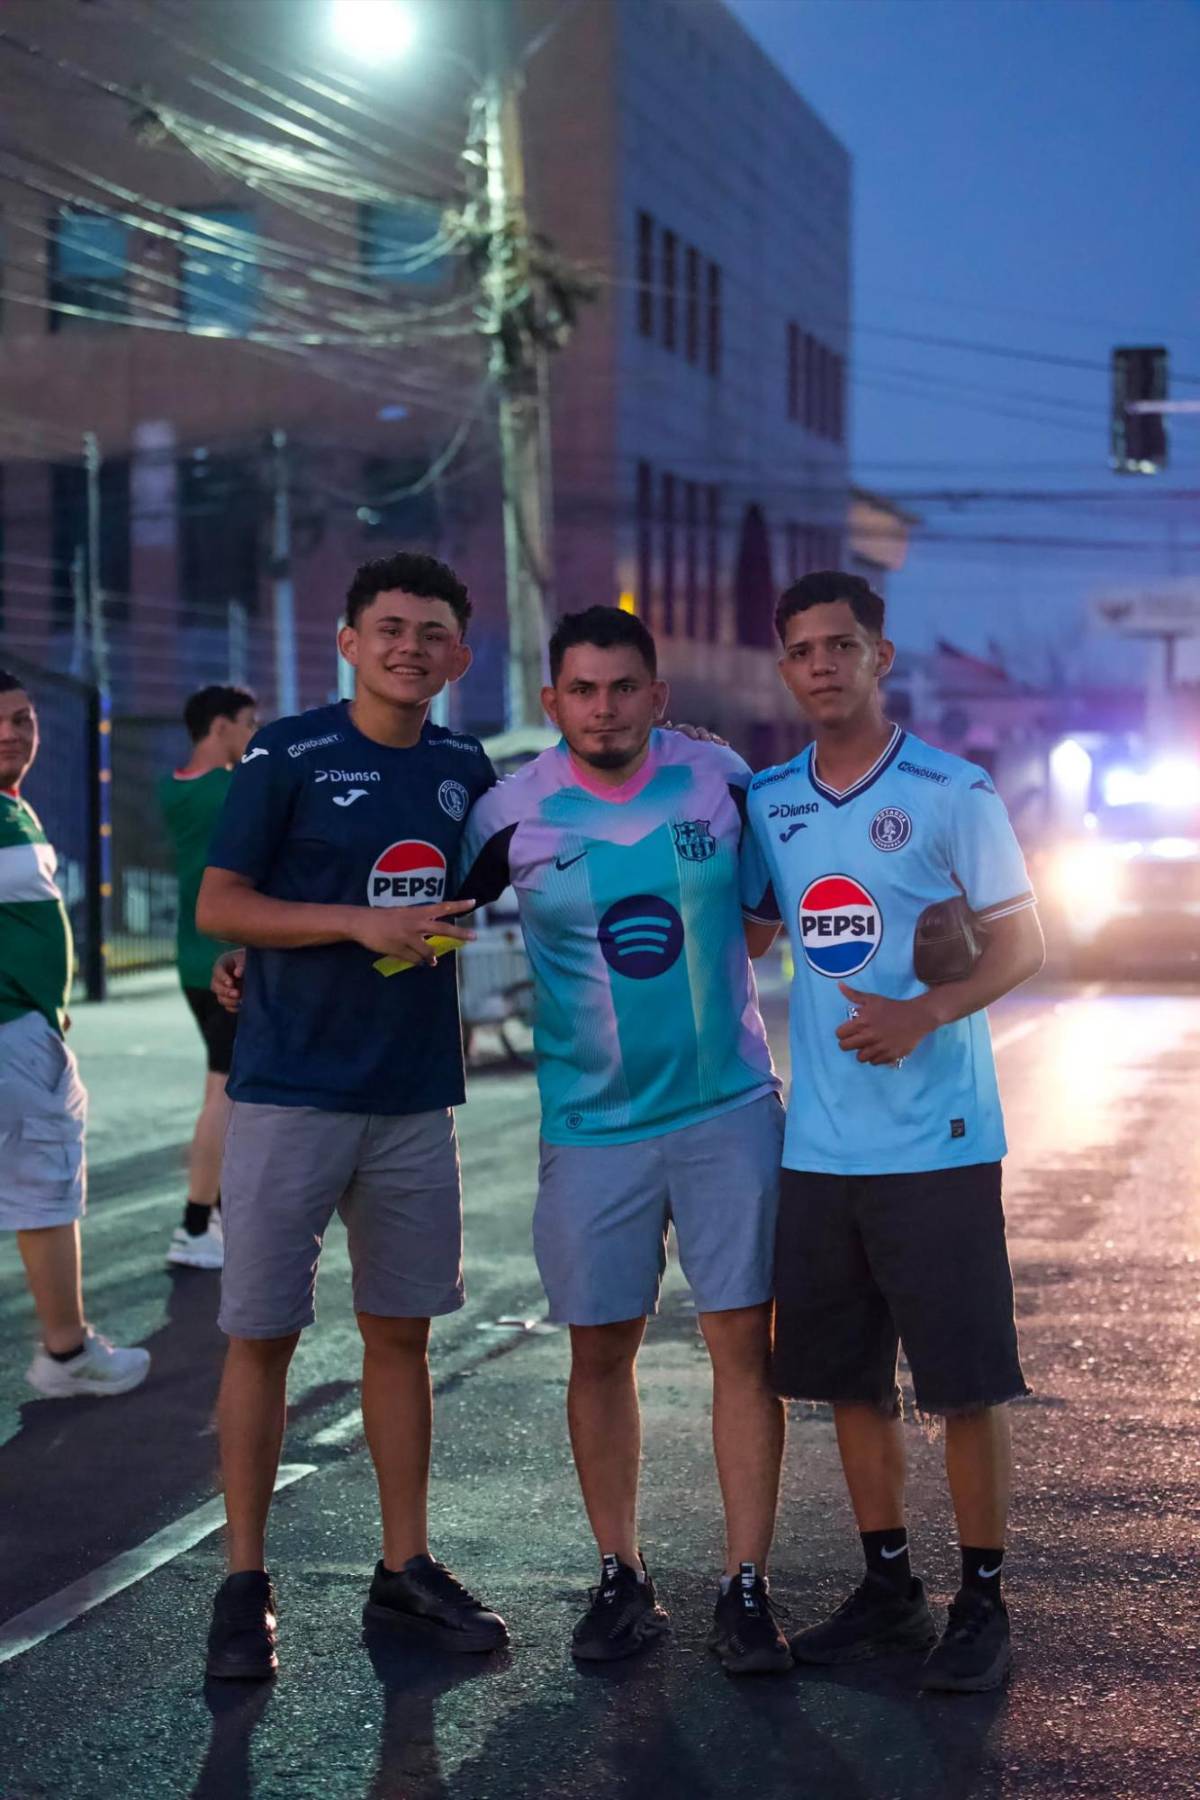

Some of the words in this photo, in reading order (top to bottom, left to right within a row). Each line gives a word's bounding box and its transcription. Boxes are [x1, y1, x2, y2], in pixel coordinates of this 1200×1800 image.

[329, 769, 381, 782] Diunsa
[779, 801, 820, 819] Diunsa
[373, 876, 444, 897] PEPSI
[801, 915, 875, 937] PEPSI
